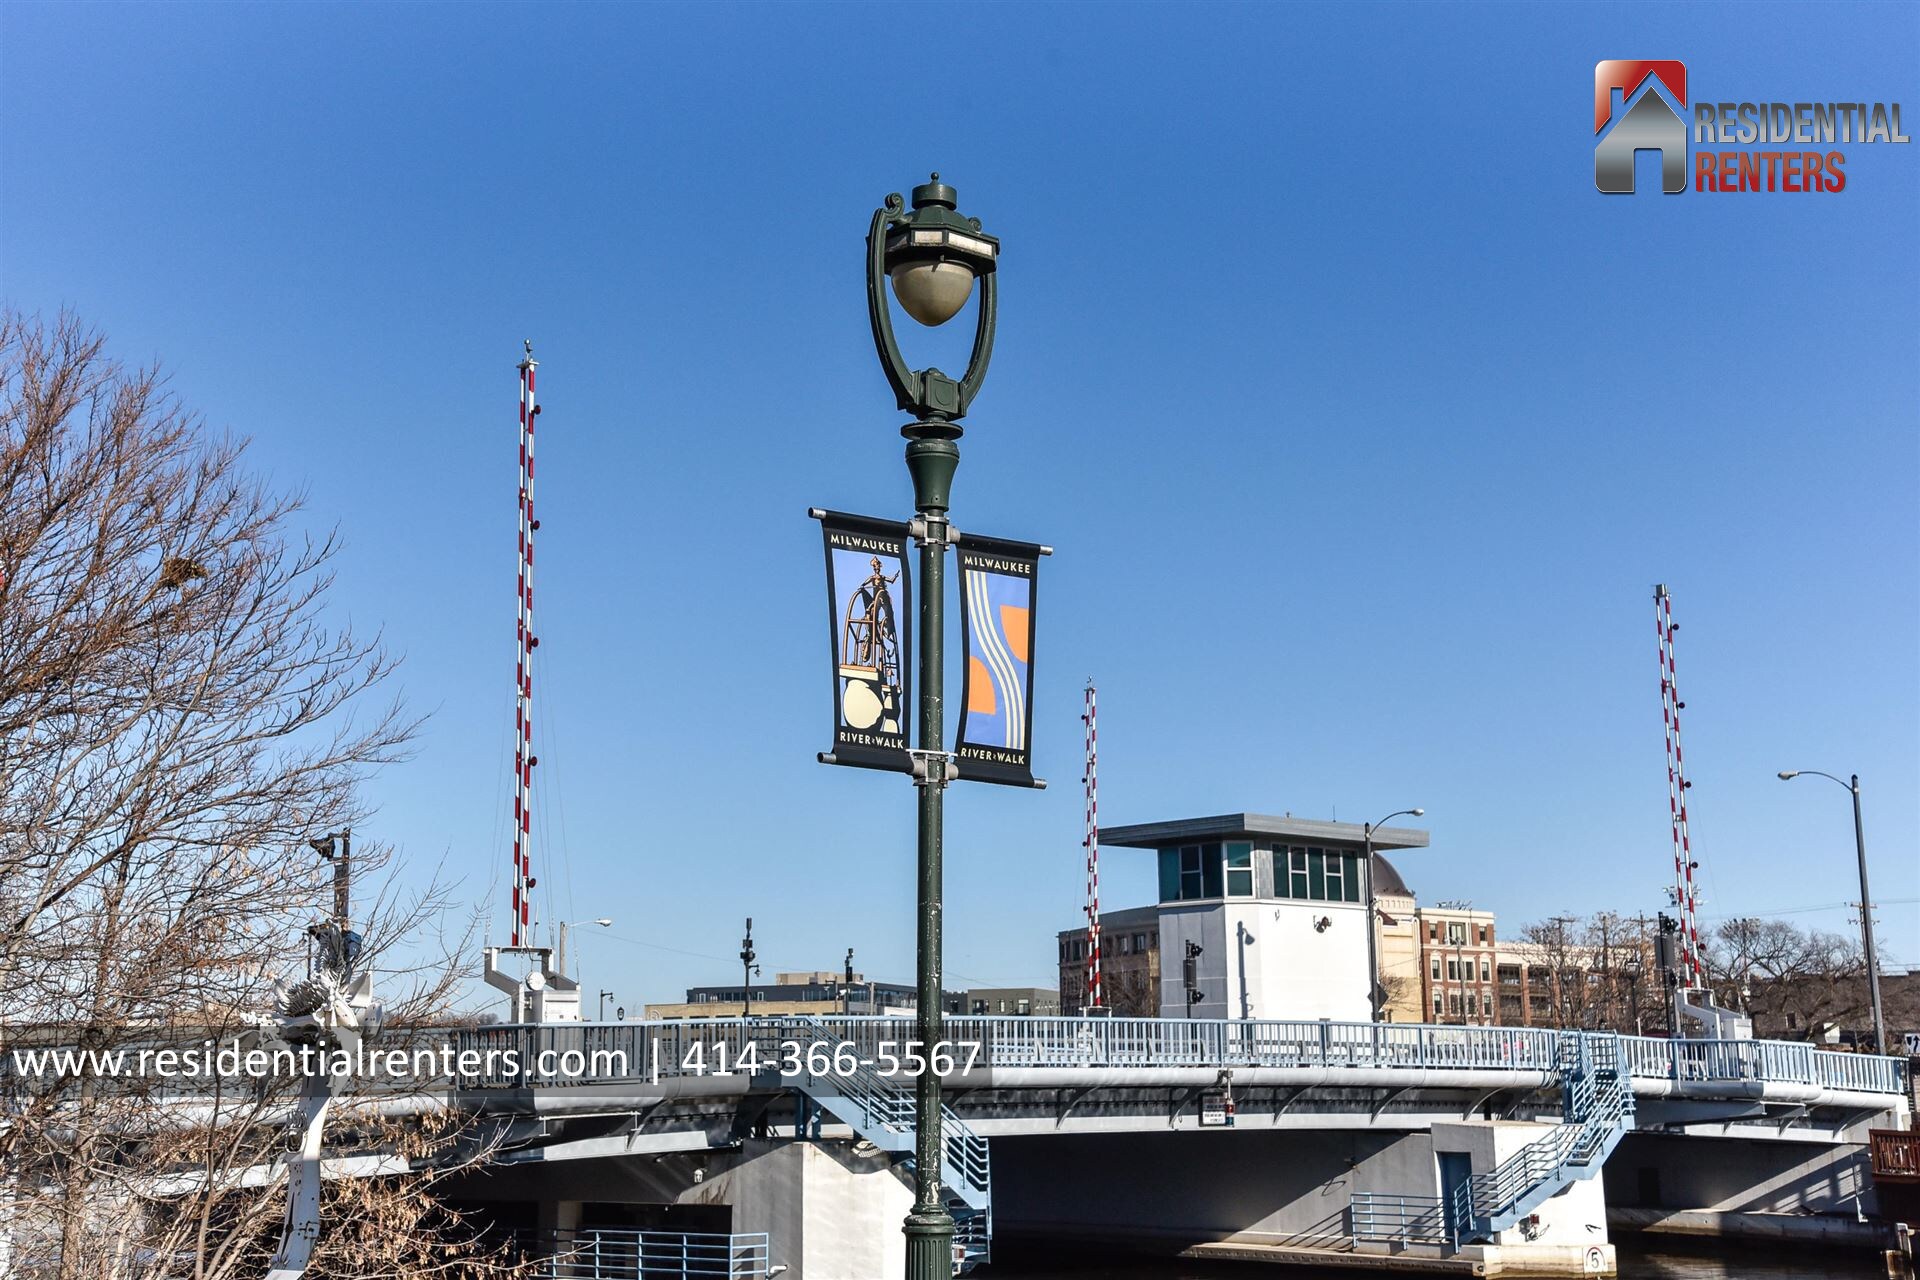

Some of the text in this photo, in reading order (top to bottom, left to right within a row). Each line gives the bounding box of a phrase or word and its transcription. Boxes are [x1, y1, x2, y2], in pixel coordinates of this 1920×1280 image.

[830, 534, 900, 554] MILWAUKEE
[964, 555, 1031, 574] MILWAUKEE
[1591, 1251, 1600, 1269] 5
